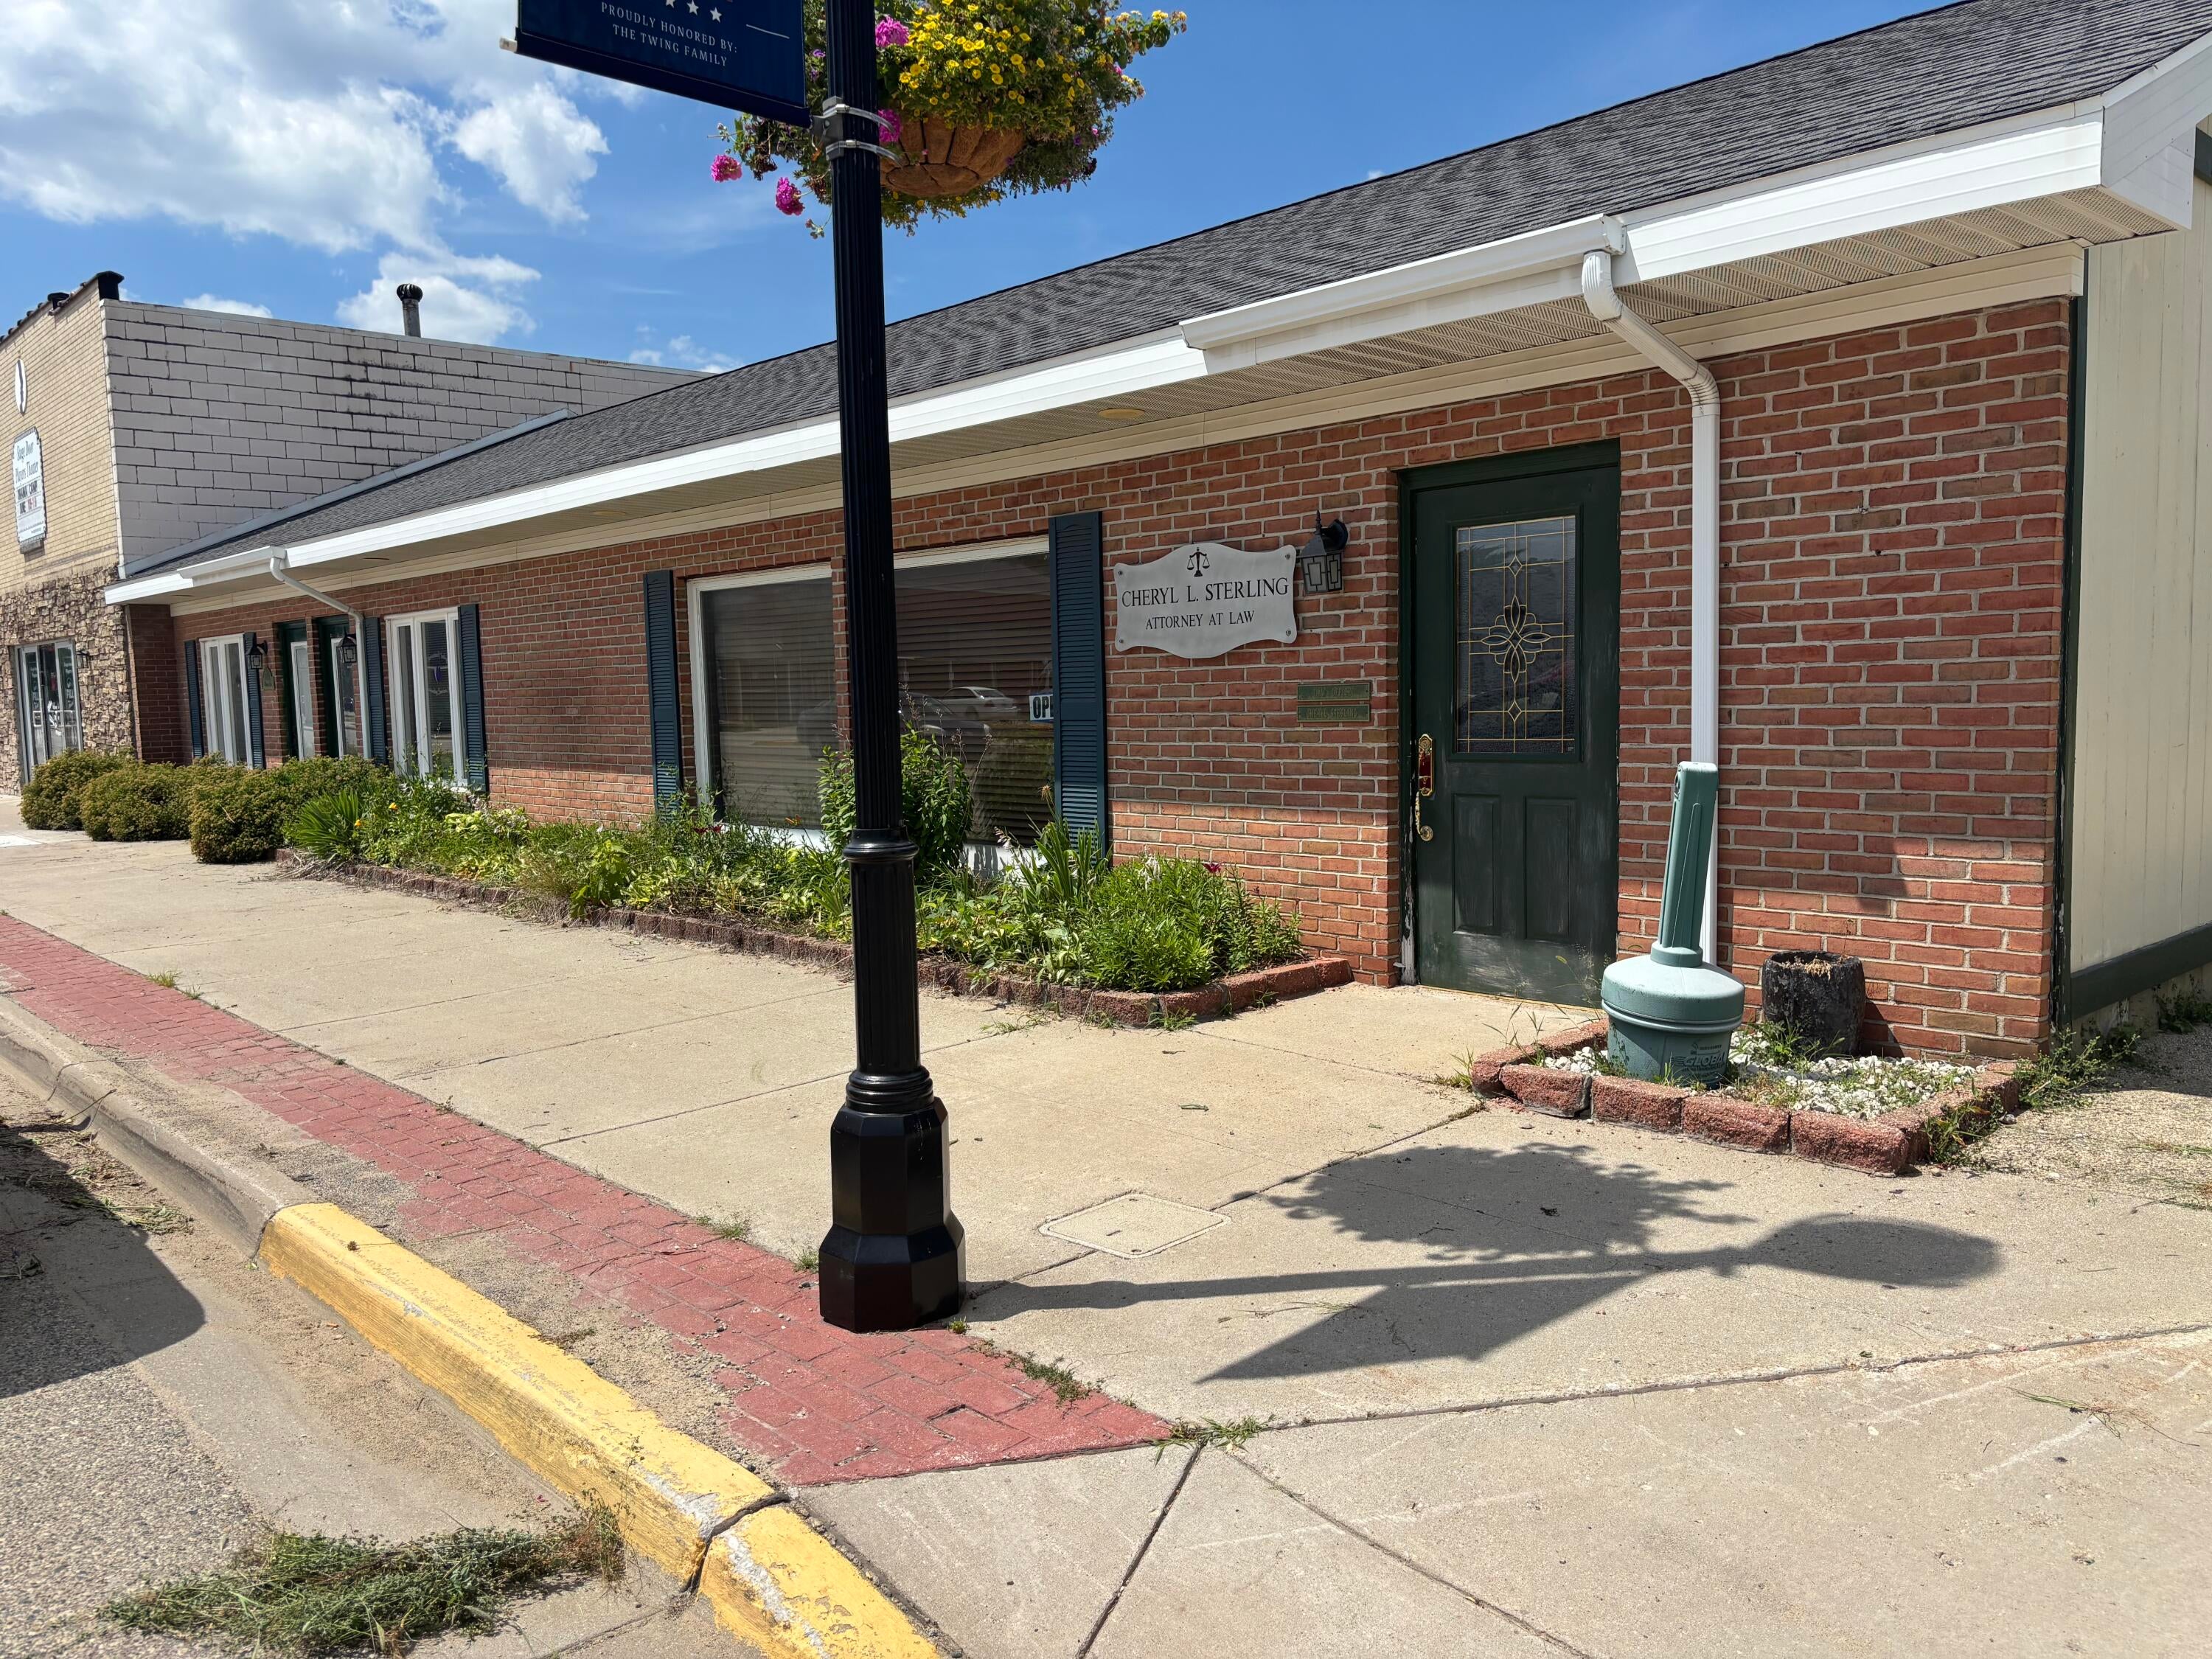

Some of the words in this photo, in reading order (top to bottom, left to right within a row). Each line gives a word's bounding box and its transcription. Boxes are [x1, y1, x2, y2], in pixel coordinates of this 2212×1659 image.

[601, 1, 655, 28] PROUDLY
[661, 21, 715, 46] HONORED
[720, 38, 737, 53] BY:
[613, 24, 636, 41] THE
[640, 32, 679, 54] TWING
[684, 46, 728, 67] FAMILY
[1121, 587, 1179, 608] CHERYL
[1187, 585, 1199, 602] L.
[1205, 577, 1290, 601] STERLING
[1145, 613, 1203, 630] ATTORNEY
[1208, 612, 1224, 626] AT
[1229, 610, 1255, 625] LAW
